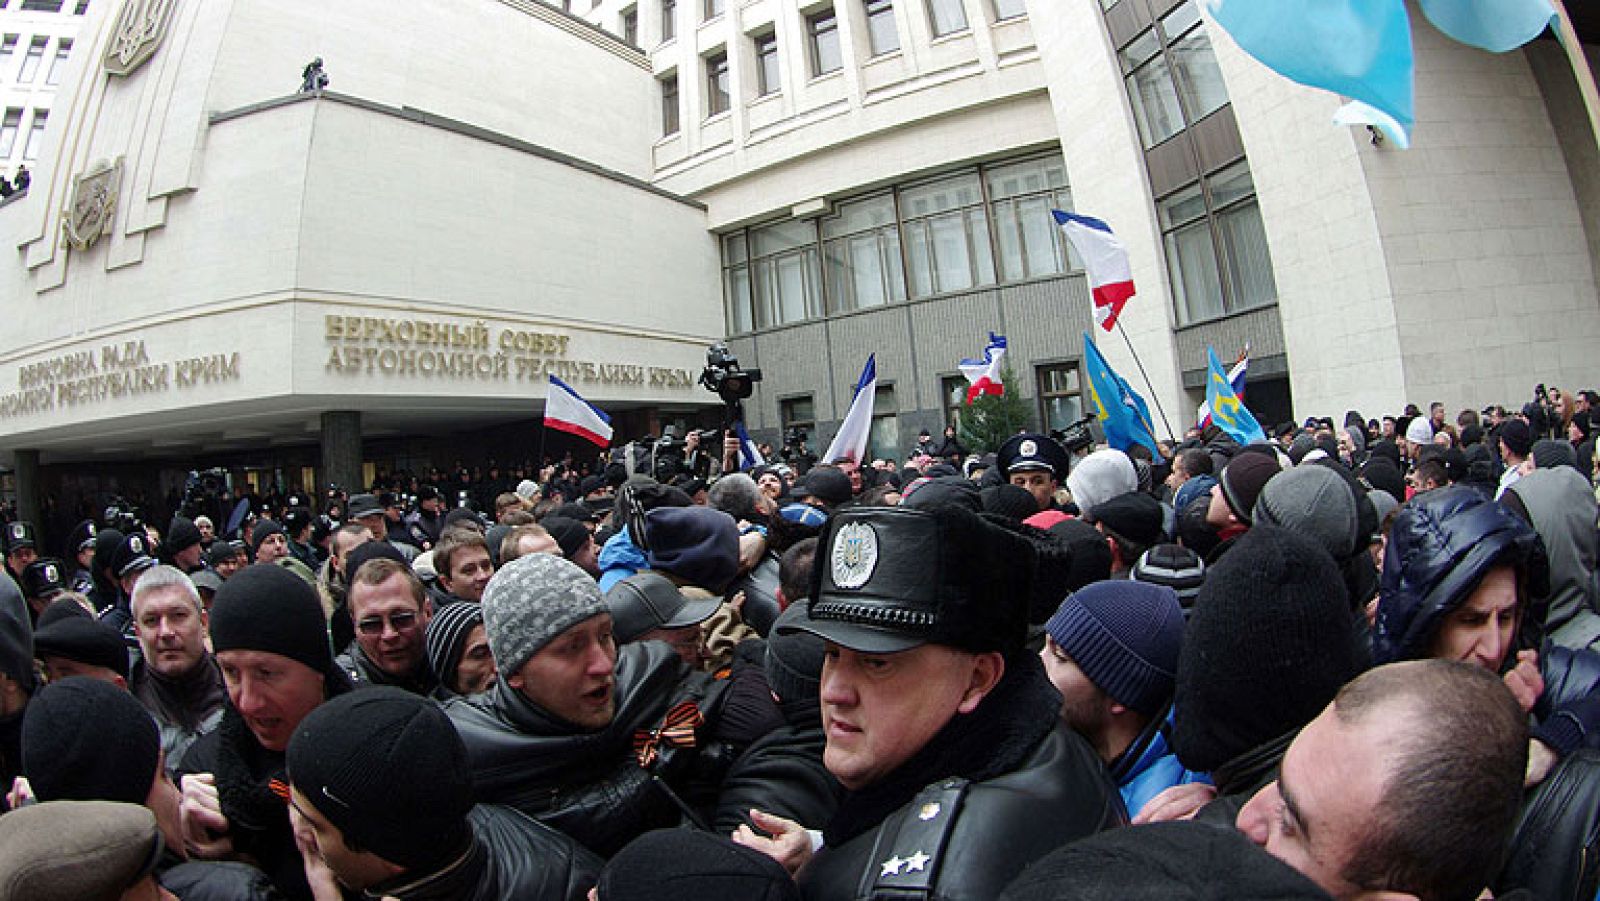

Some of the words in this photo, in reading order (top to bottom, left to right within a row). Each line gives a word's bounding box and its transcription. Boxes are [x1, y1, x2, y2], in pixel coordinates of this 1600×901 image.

[101, 340, 149, 371] РАДА
[325, 314, 490, 350] ВЕРХОВНЫЙ
[499, 328, 570, 357] СОВЕТ
[175, 351, 241, 389] КРИМ
[325, 345, 509, 379] АВТОНОМНОЙ
[513, 356, 645, 387] РЕСПУБЛИКИ
[649, 366, 695, 389] КРЫМ
